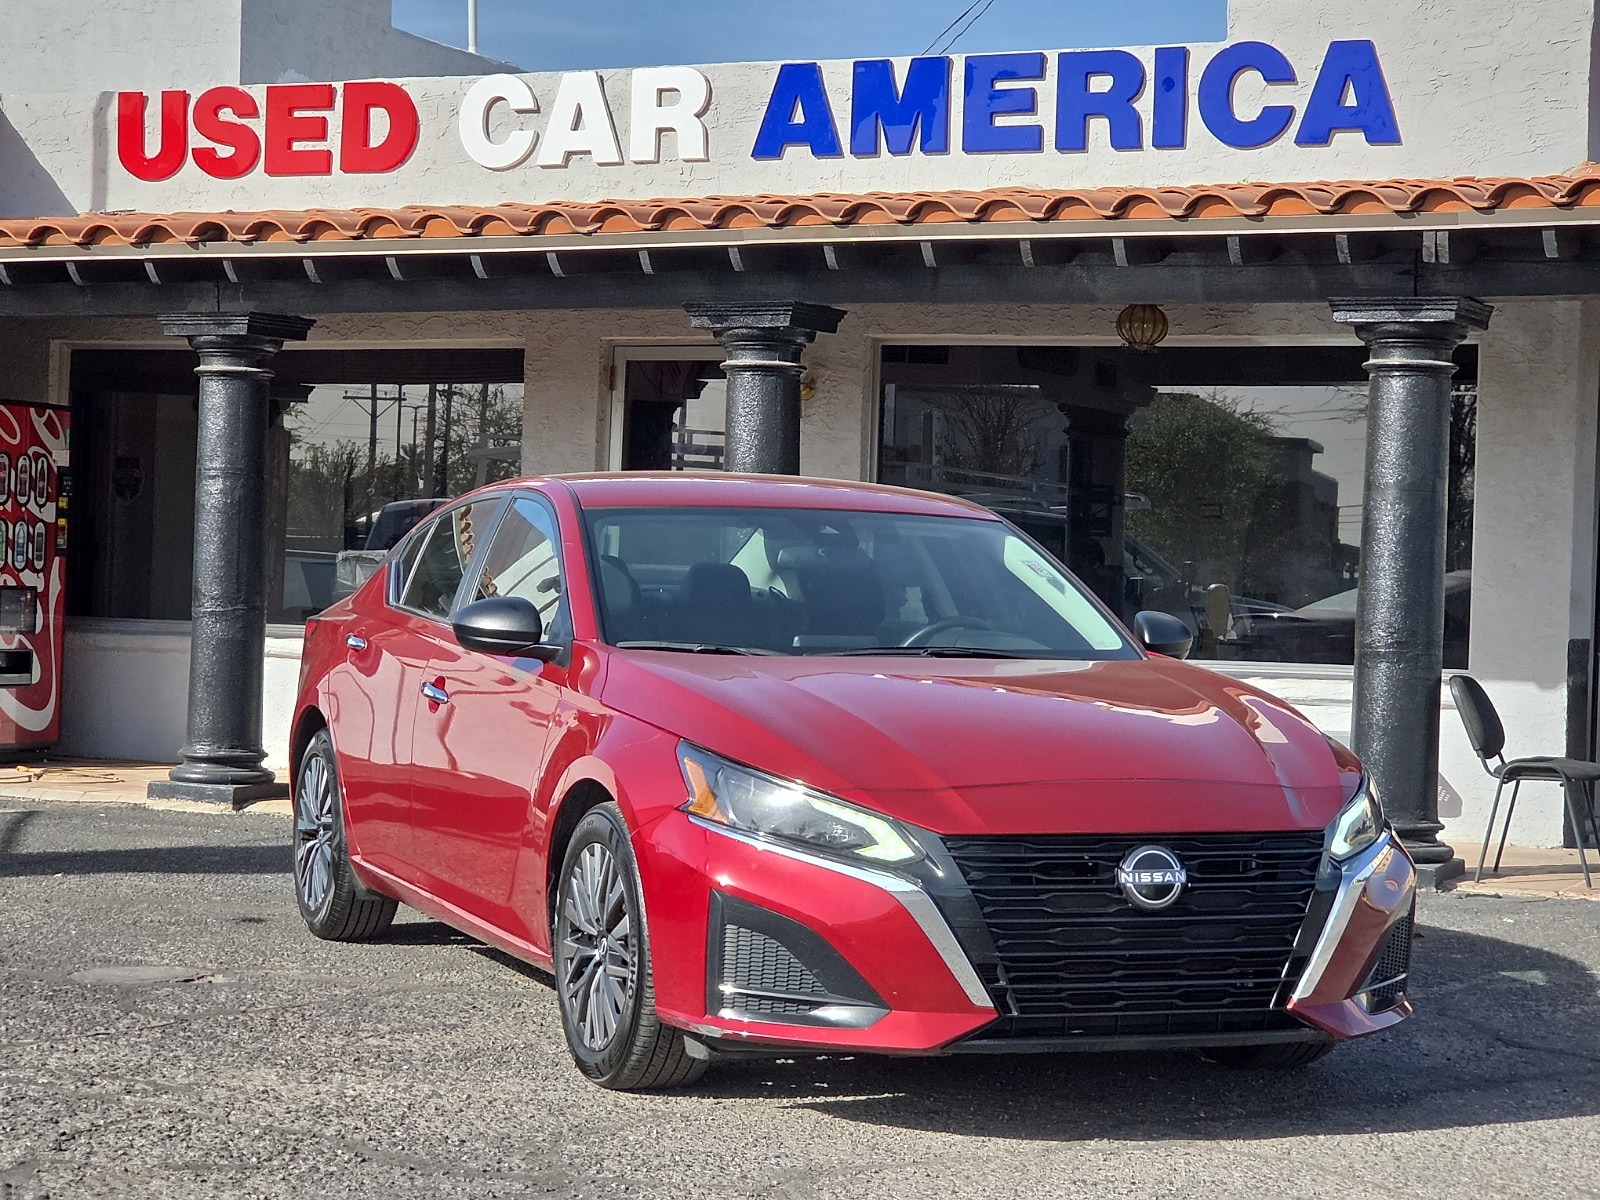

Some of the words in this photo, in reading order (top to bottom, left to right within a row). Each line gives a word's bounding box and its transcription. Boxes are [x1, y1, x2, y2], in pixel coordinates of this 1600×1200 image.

[117, 81, 420, 182] USED
[459, 68, 711, 171] CAR
[751, 39, 1402, 160] AMERICA
[1121, 872, 1186, 883] NISSAN
